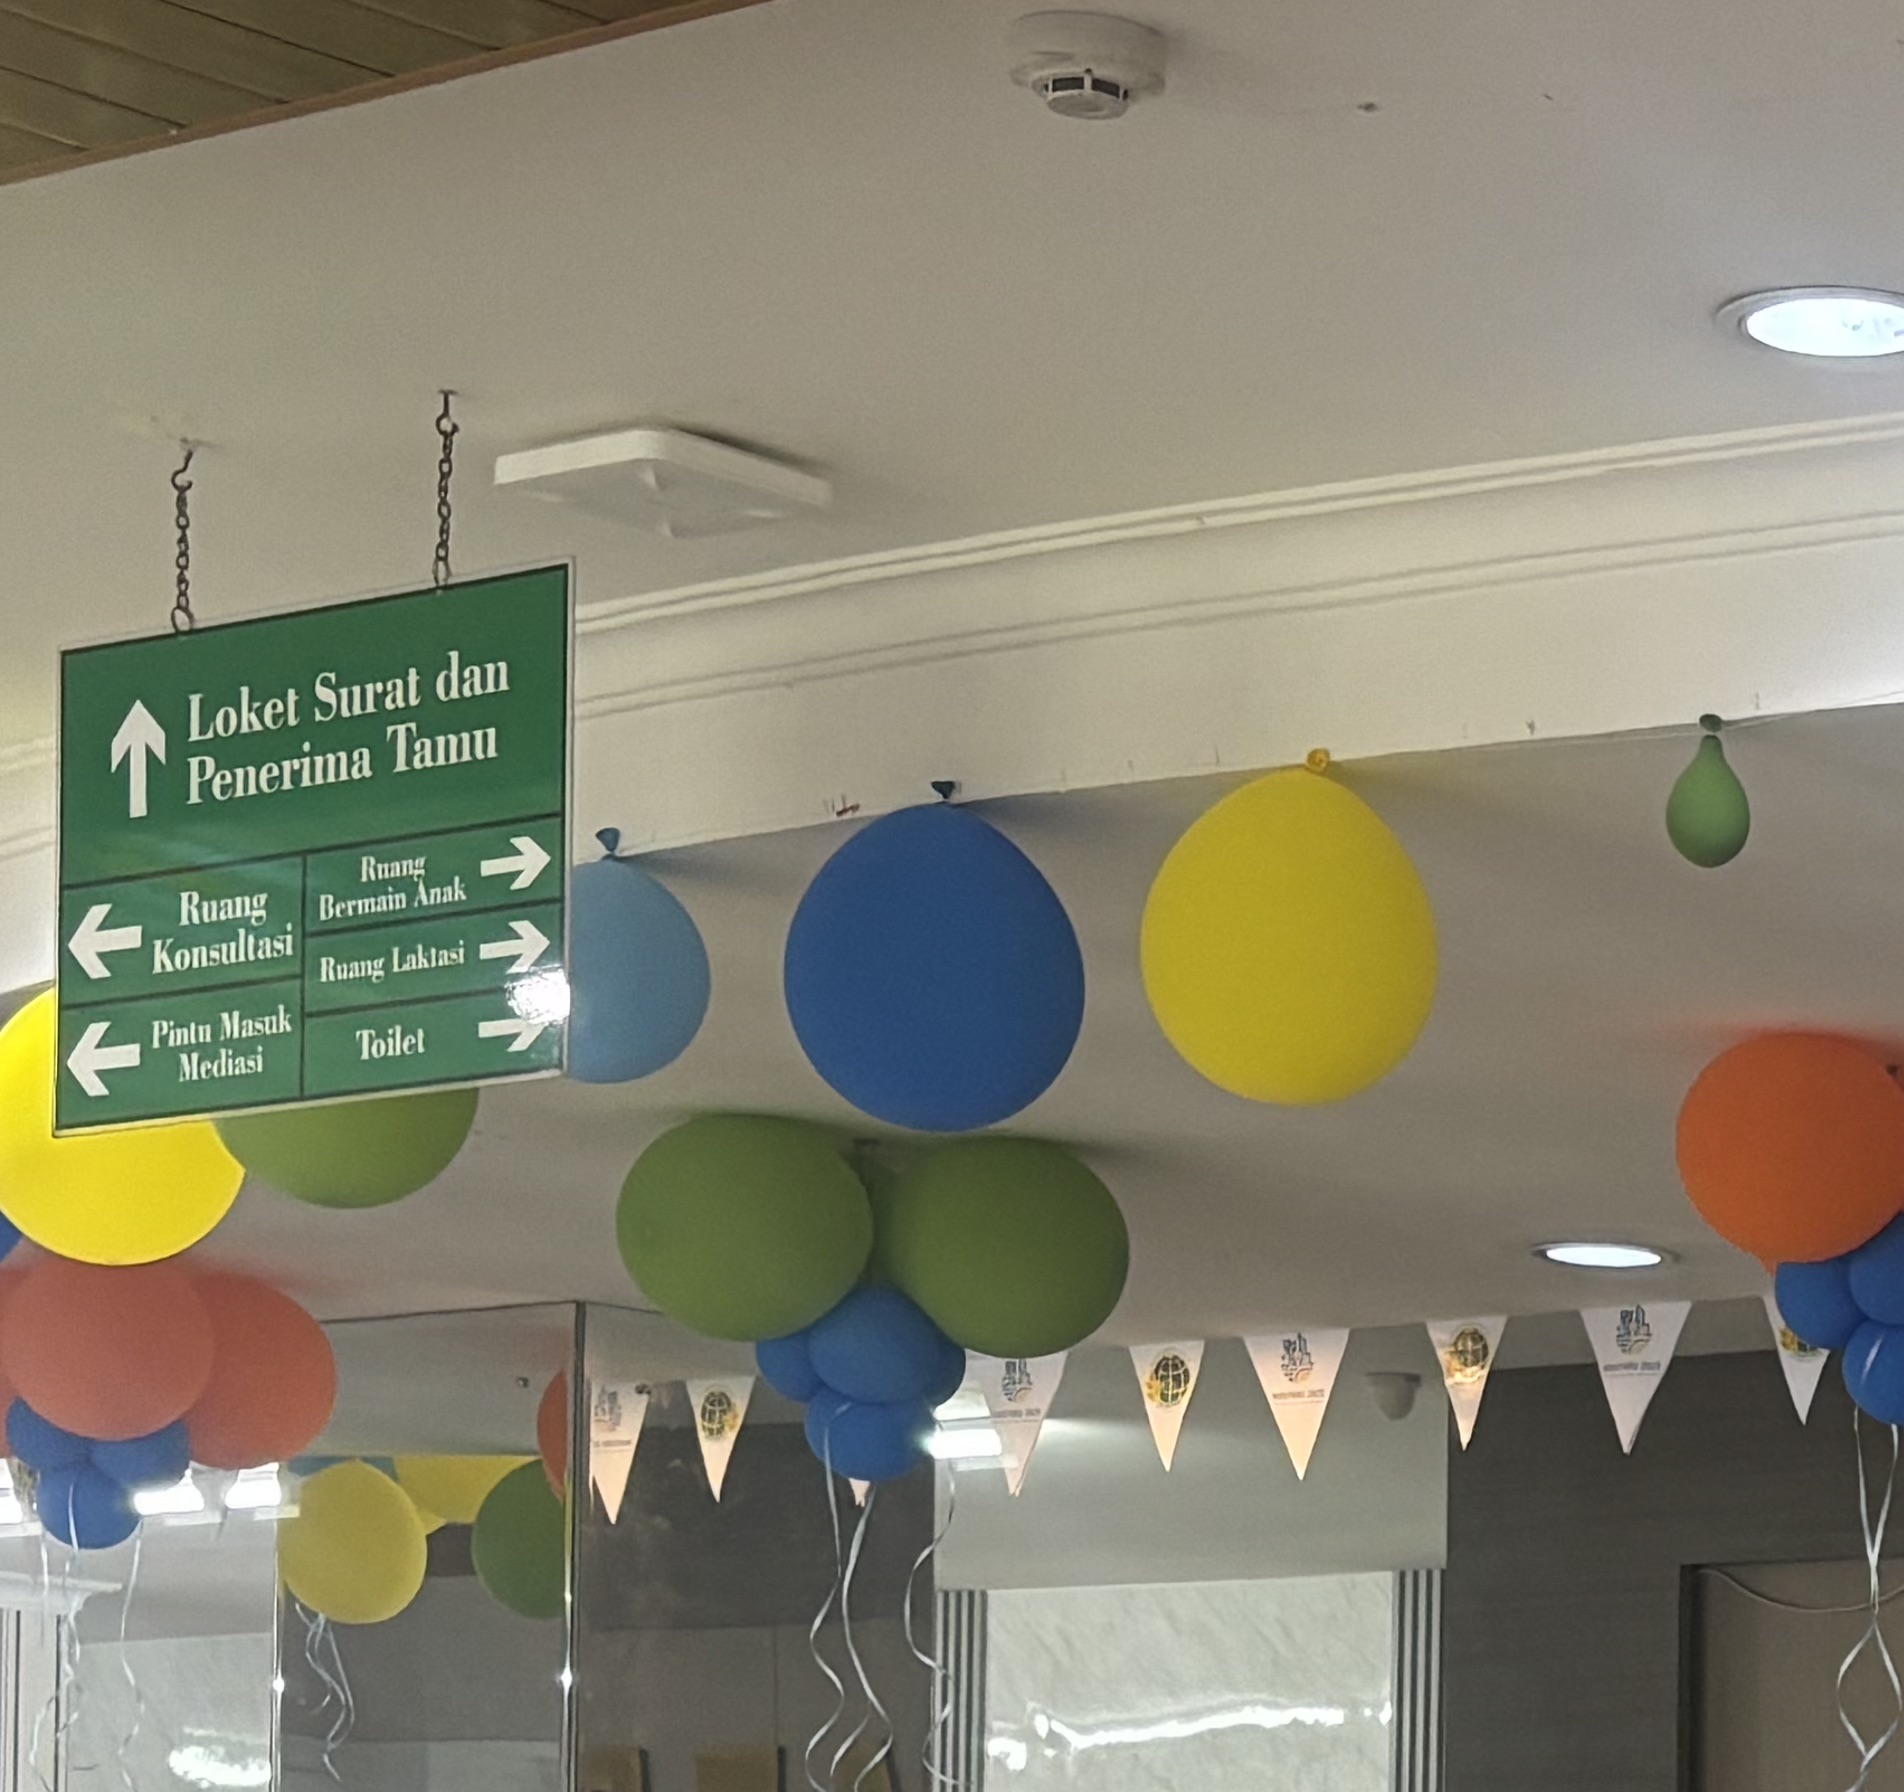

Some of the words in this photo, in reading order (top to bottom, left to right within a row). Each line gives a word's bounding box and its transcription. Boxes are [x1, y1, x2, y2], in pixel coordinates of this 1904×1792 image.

[186, 687, 300, 743] Loket
[314, 666, 421, 724] Surat
[436, 651, 509, 701] dan
[186, 742, 373, 806] Penerima
[386, 721, 499, 774] Tamu
[360, 854, 426, 884] Ruang
[180, 889, 268, 926] Ruang
[318, 885, 407, 921] Bermain
[414, 877, 467, 907] Anak
[151, 924, 294, 975] Konsultasi
[319, 955, 384, 983] Ruang
[391, 940, 466, 972] Laktasi
[151, 1015, 212, 1049] Pintu
[220, 1004, 292, 1038] Masuk
[356, 1027, 425, 1061] Toilet
[178, 1046, 263, 1082] Mediasi
